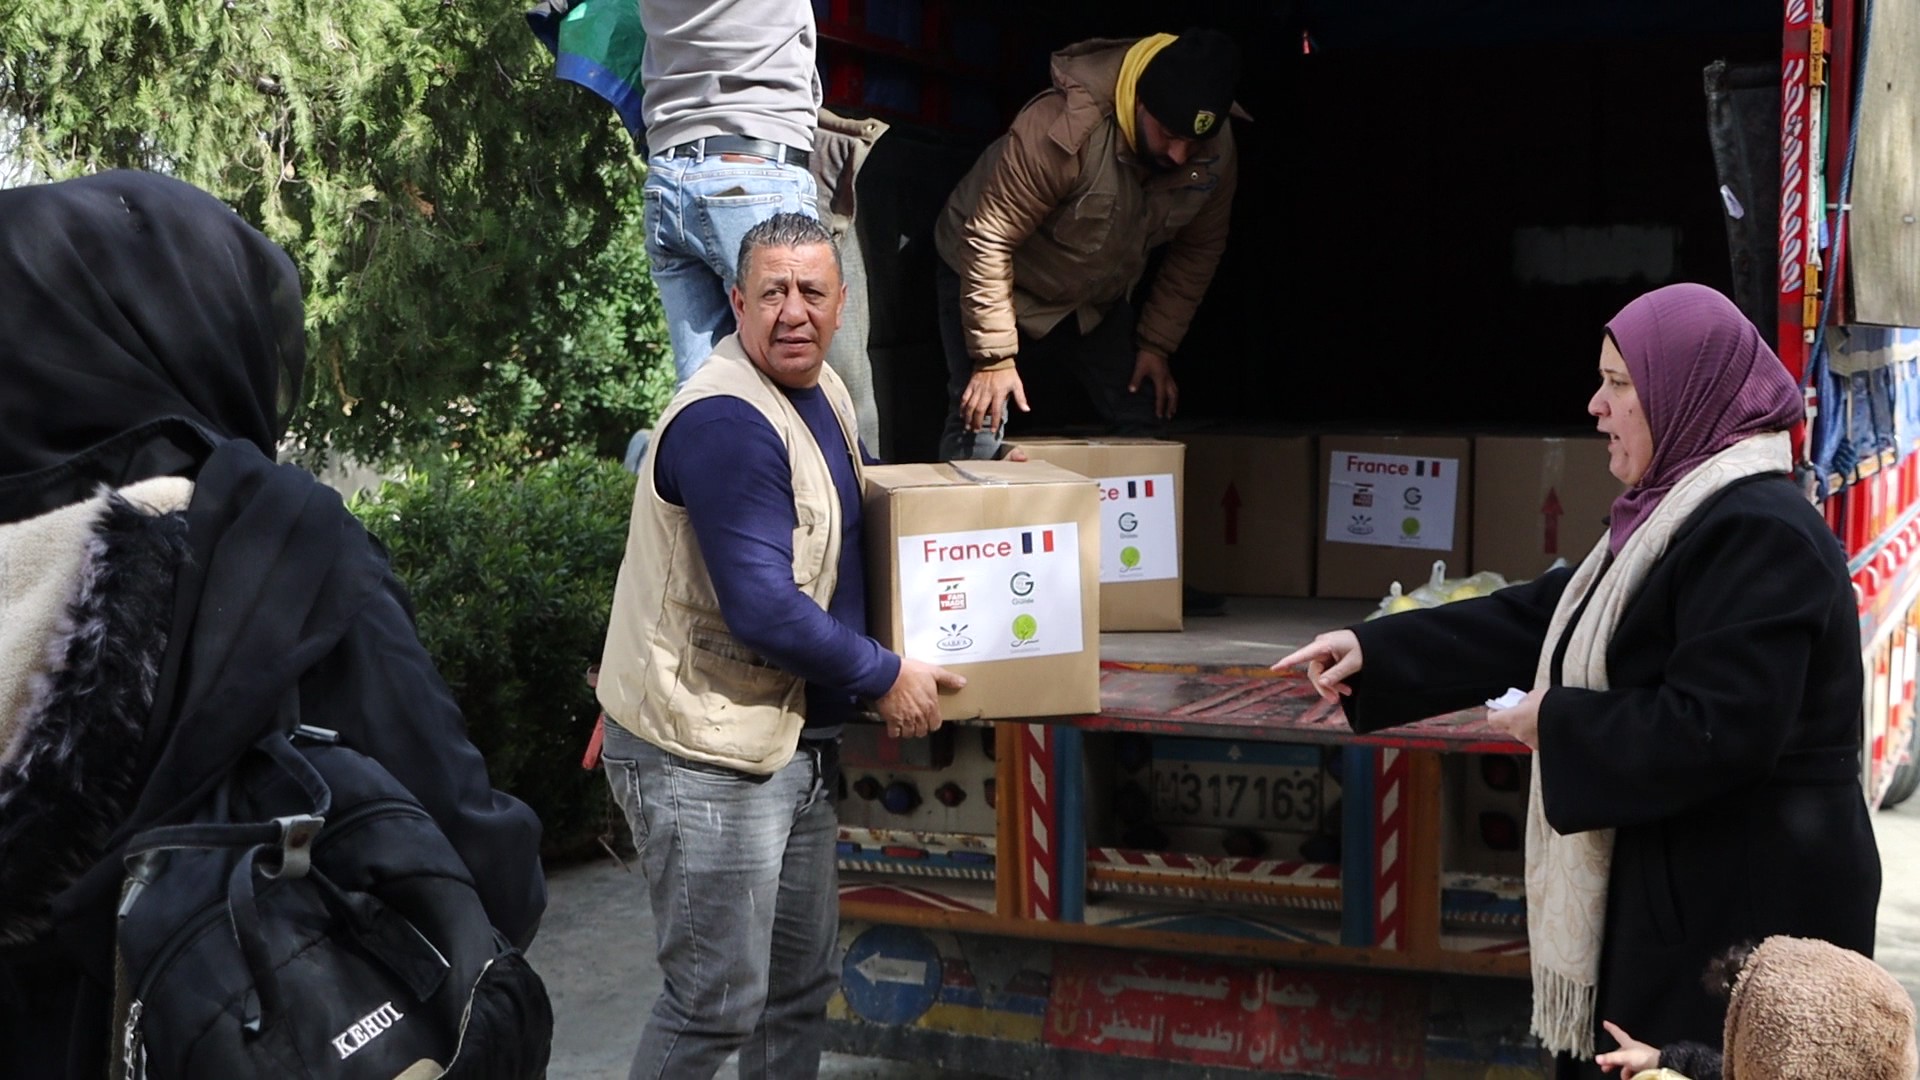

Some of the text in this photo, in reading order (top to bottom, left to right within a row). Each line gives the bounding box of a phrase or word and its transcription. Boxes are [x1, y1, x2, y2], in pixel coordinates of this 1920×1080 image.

[1346, 455, 1409, 476] France
[923, 539, 1012, 563] France
[331, 1001, 404, 1060] KEHUI
